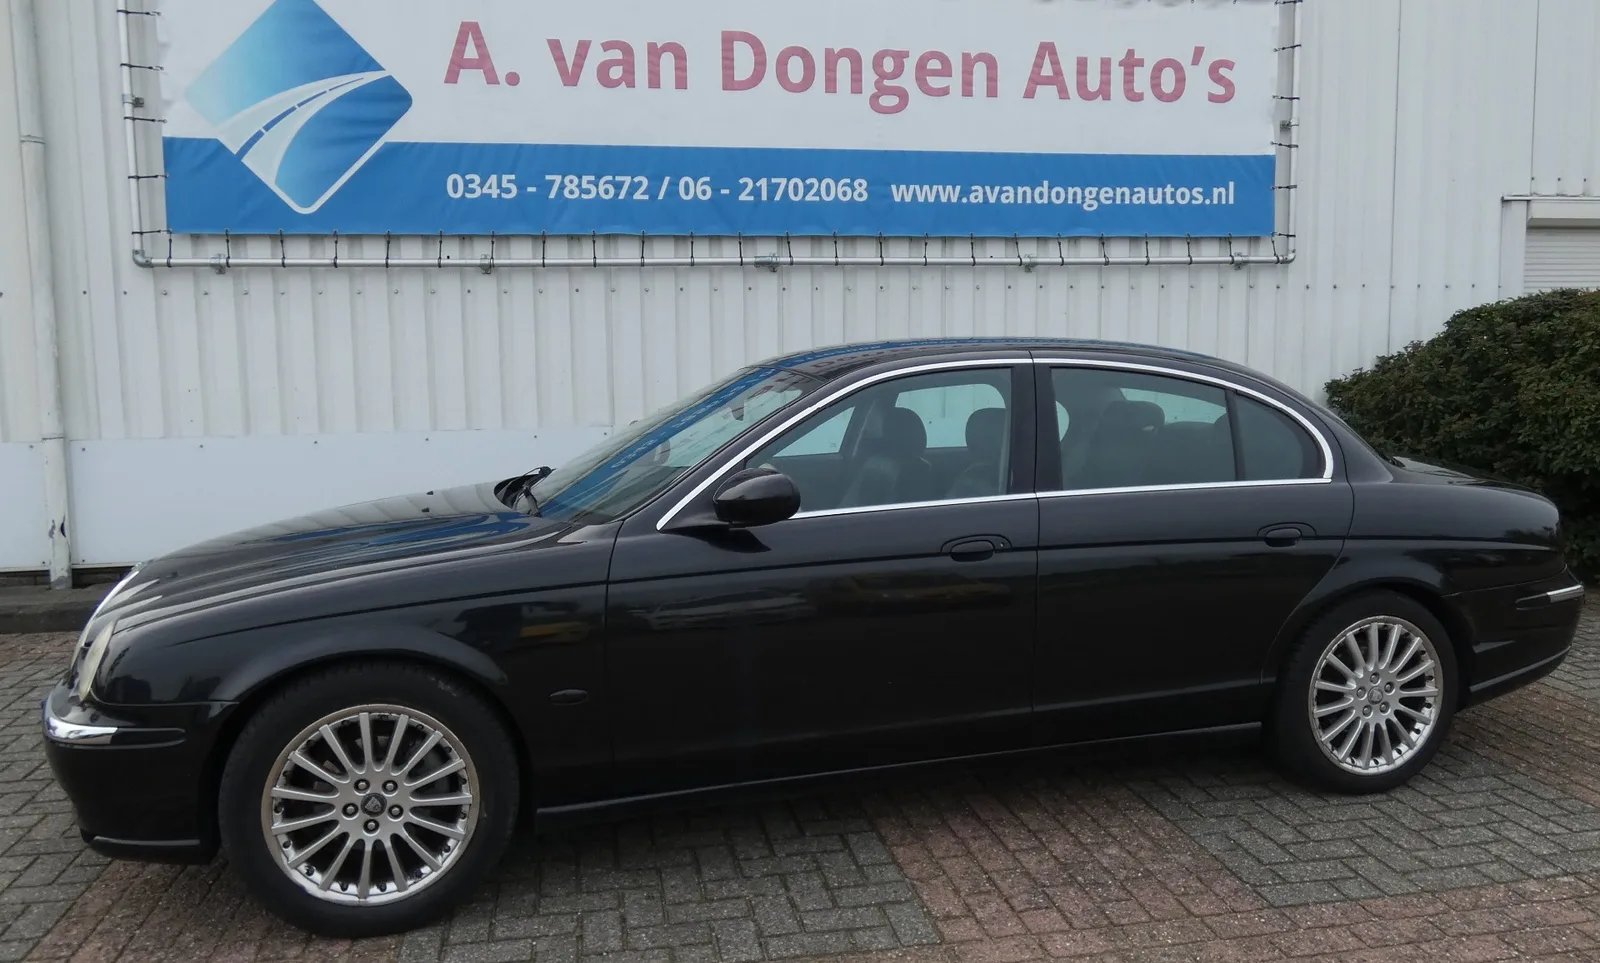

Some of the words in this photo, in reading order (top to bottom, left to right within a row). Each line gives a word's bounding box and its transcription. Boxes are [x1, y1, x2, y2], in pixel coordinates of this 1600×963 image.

[446, 22, 519, 86] A.
[546, 39, 688, 90] van
[721, 30, 998, 114] Dongen
[446, 173, 518, 199] 0345
[545, 174, 649, 201] 785672
[678, 176, 712, 201] 06
[738, 177, 868, 203] 21702068
[890, 180, 1235, 211] www.avandongenautos.nl
